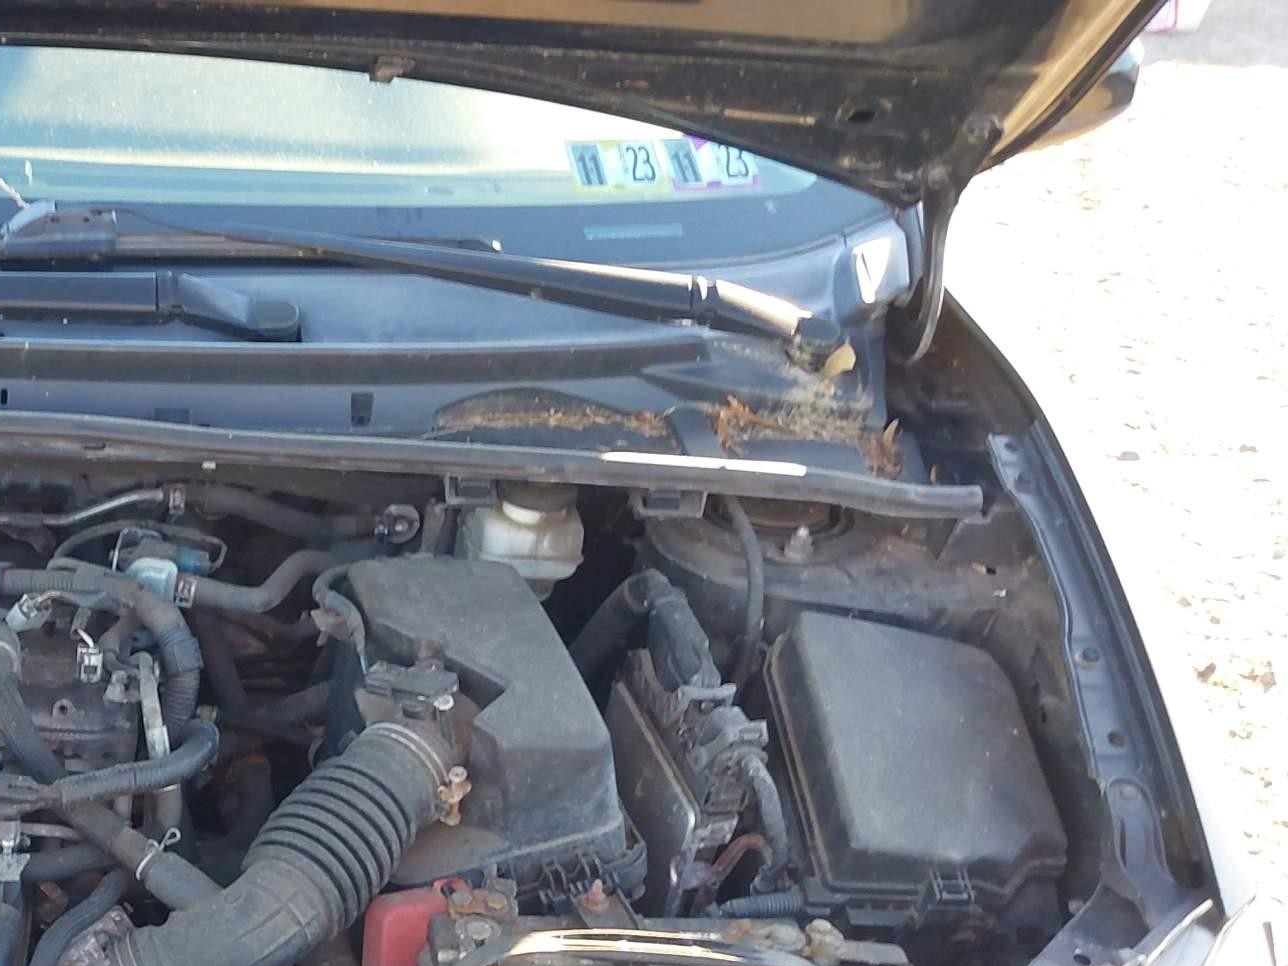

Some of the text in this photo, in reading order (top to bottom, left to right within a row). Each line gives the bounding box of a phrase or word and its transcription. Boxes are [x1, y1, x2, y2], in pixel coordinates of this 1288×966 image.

[576, 146, 656, 186] 11 23
[671, 151, 702, 183] 11
